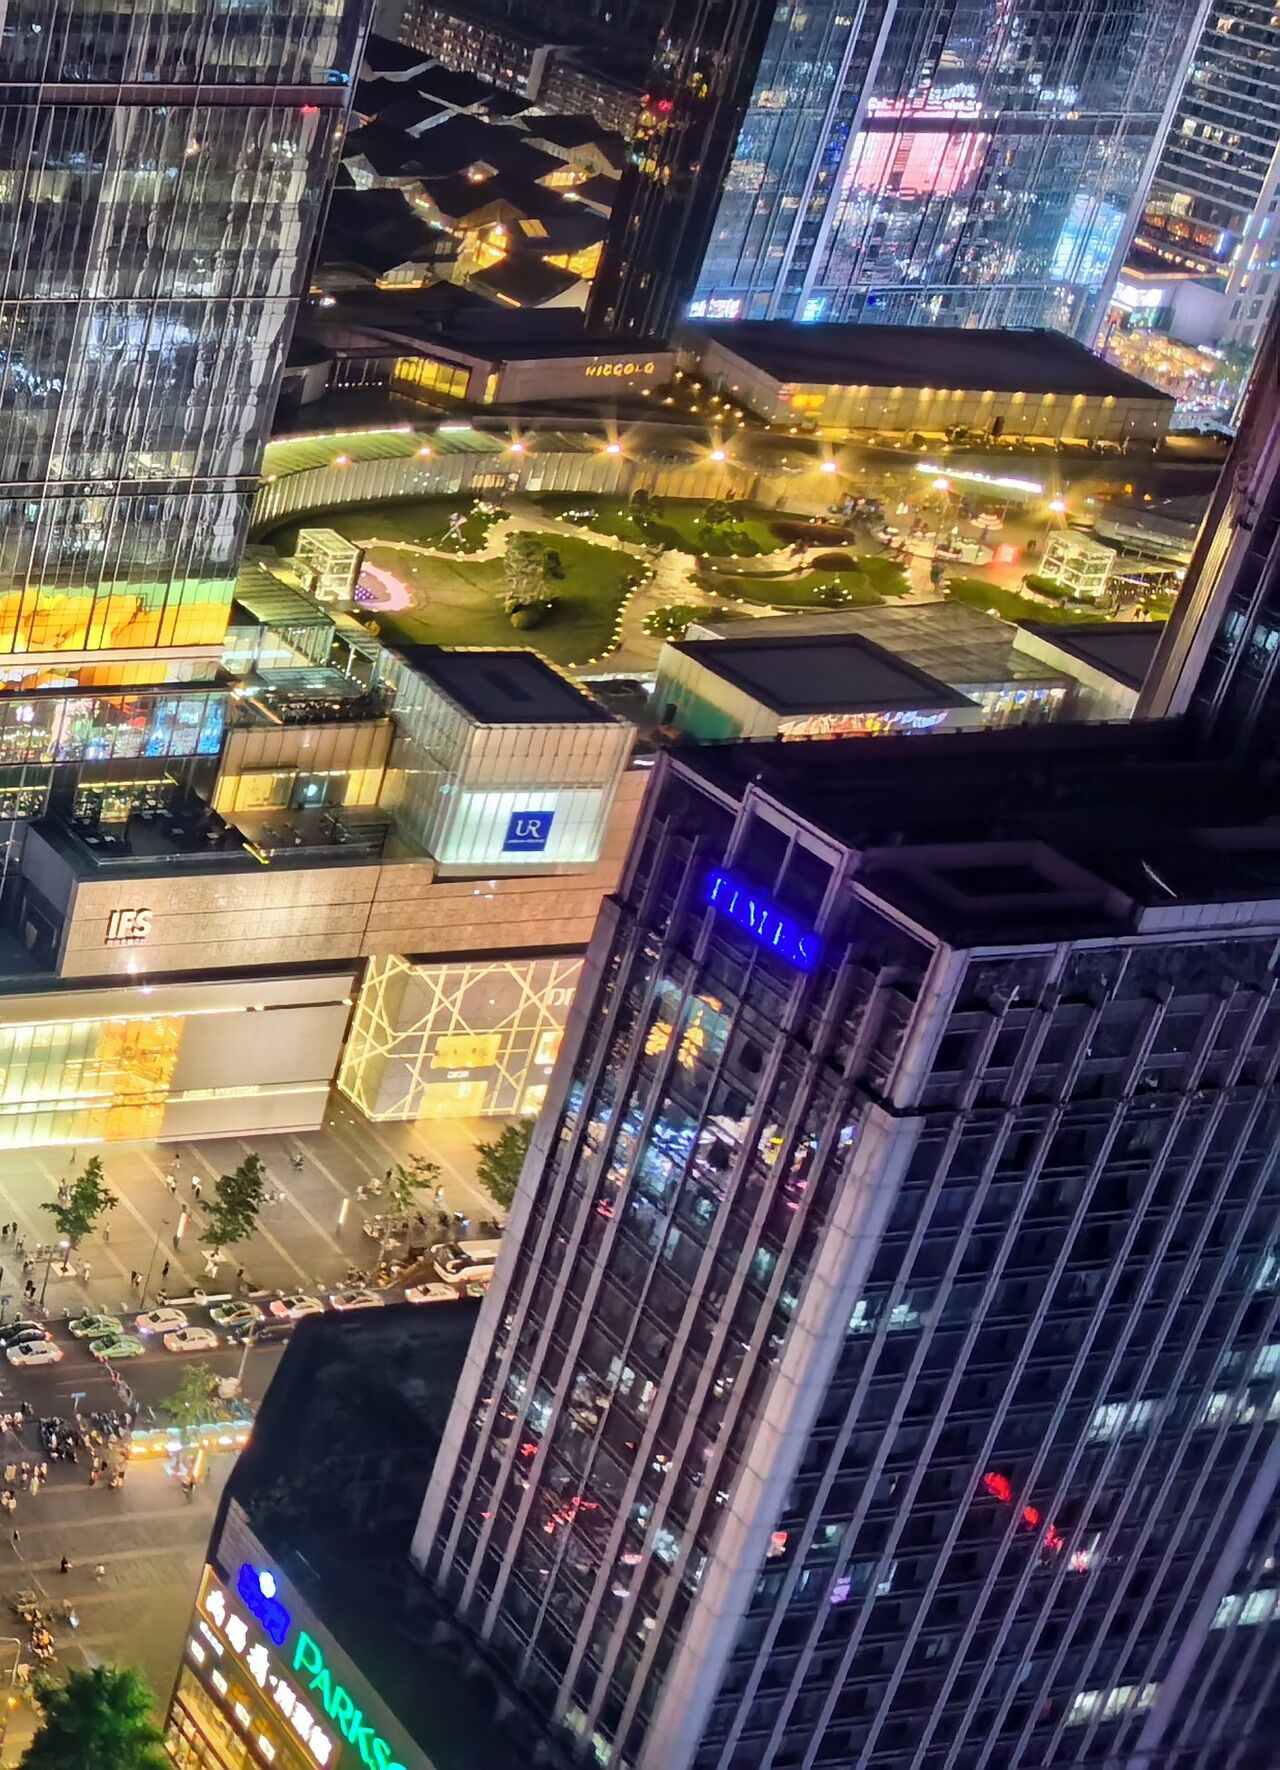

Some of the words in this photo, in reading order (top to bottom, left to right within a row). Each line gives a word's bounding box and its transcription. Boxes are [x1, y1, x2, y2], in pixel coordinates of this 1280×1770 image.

[515, 819, 542, 838] UR
[105, 908, 154, 939] IFS
[707, 871, 814, 968] TIMES
